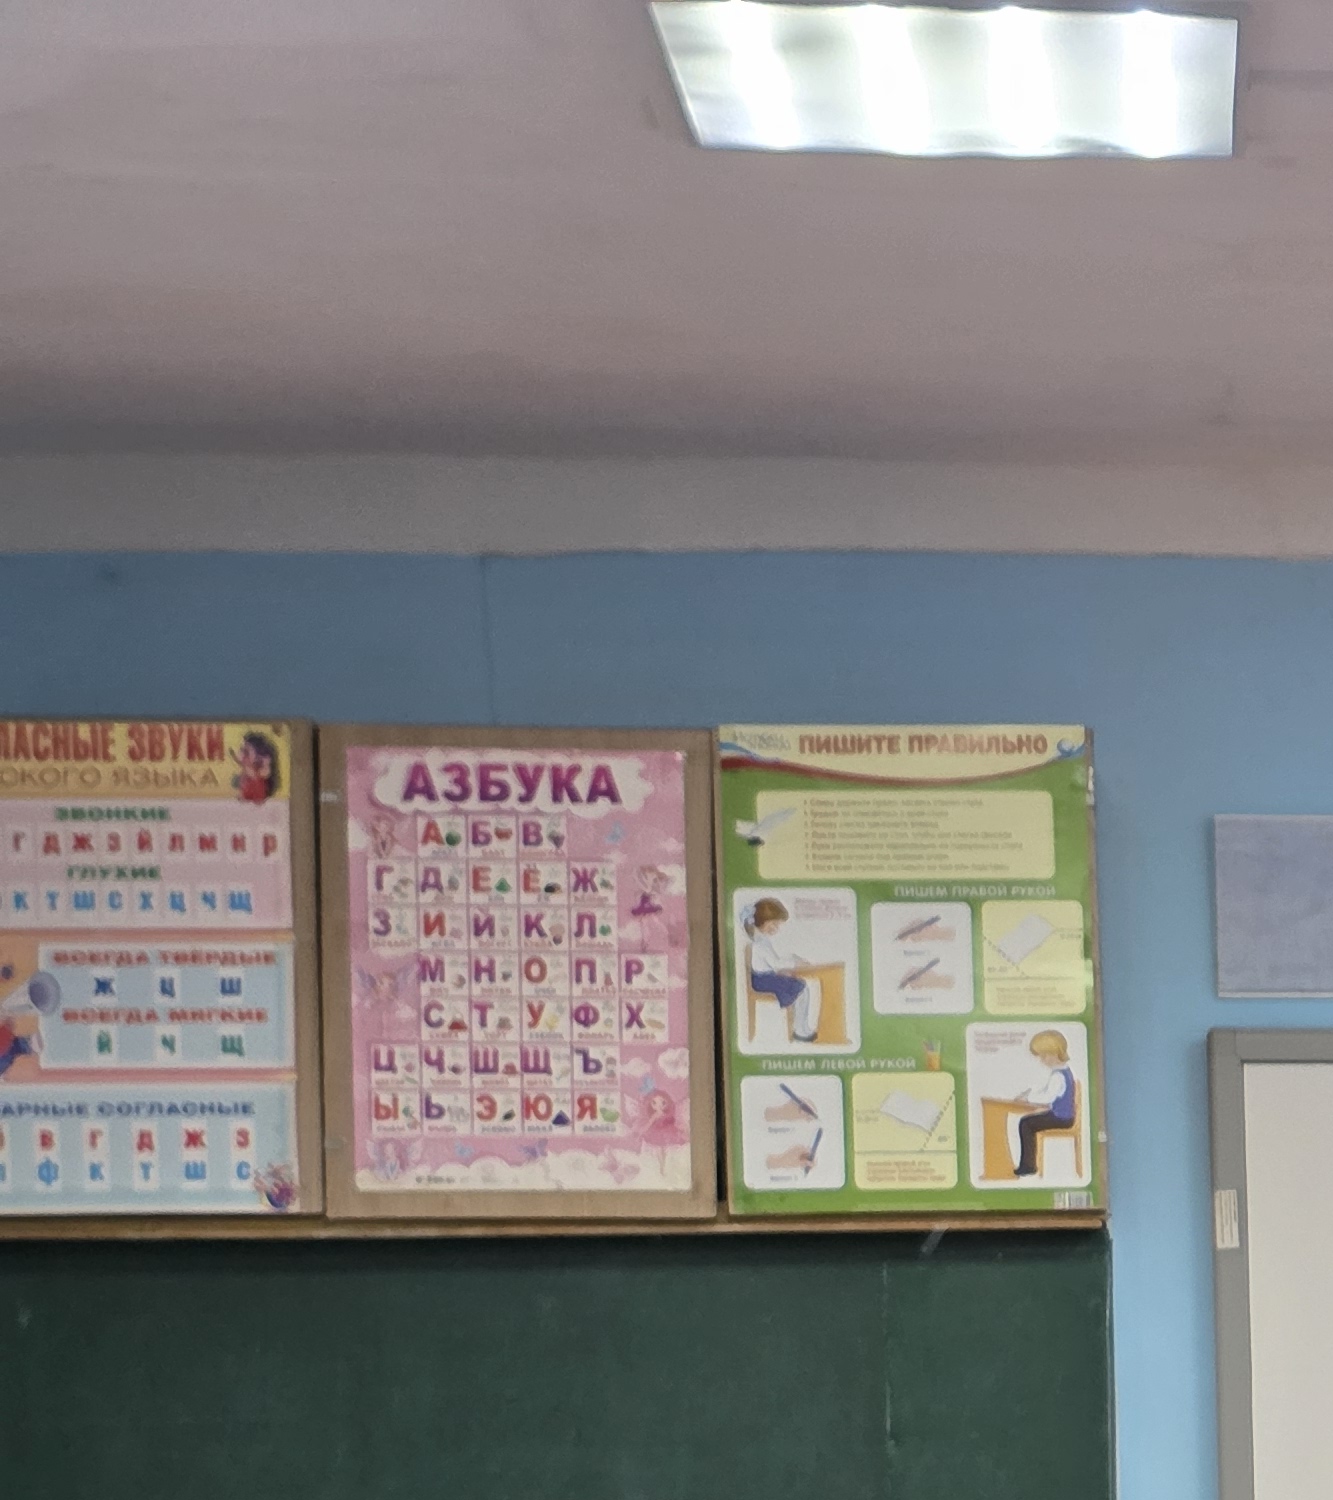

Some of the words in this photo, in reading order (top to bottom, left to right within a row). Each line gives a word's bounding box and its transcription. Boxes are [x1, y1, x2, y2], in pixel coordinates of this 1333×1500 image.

[128, 722, 225, 762] ЗВУКИ
[799, 733, 901, 754] ПИШИТЕ
[908, 733, 1048, 754] ПРАВИЛЬНО
[112, 767, 219, 788] ЯЗЫКА
[403, 759, 623, 806] АЗБУКА
[56, 807, 170, 821] ЗВОНКИЕ
[421, 820, 444, 845] А
[471, 821, 491, 847] Б
[523, 821, 543, 847] В
[375, 865, 394, 891] Г
[421, 867, 444, 893] Д
[472, 866, 492, 892] Е
[523, 863, 541, 892] Ё
[572, 867, 598, 892] Ж
[894, 886, 947, 898] ПИШЕМ
[952, 883, 1007, 897] ПРАВОЙ
[373, 909, 391, 936] З
[424, 911, 445, 937] И
[473, 907, 495, 938] Й
[524, 913, 547, 938] К
[574, 912, 597, 938] Л
[420, 955, 445, 982] М
[474, 957, 496, 983] Н
[524, 956, 547, 983] О
[575, 958, 597, 984] П
[625, 958, 644, 984] Р
[424, 1001, 444, 1029] С
[474, 1001, 494, 1028] Т
[527, 1001, 545, 1029] У
[574, 1001, 600, 1029] Ф
[625, 1002, 645, 1029] Х
[374, 1046, 397, 1073] Ц
[424, 1047, 445, 1074] Ч
[474, 1046, 499, 1074] Ш
[522, 1046, 553, 1075] Щ
[575, 1047, 603, 1074] Ъ
[762, 1059, 816, 1070] ПИШЕМ
[821, 1056, 866, 1070] ЛЕВОЙ
[870, 1056, 916, 1070] РУКОЙ
[0, 1101, 88, 1117] АРНЫЕ
[97, 1101, 255, 1117] СОГЛАСНЫЕ
[374, 1093, 399, 1120] Ы
[424, 1093, 446, 1120] Ь
[476, 1093, 498, 1121] Э
[524, 1093, 553, 1121] Ю
[577, 1093, 598, 1121] Я
